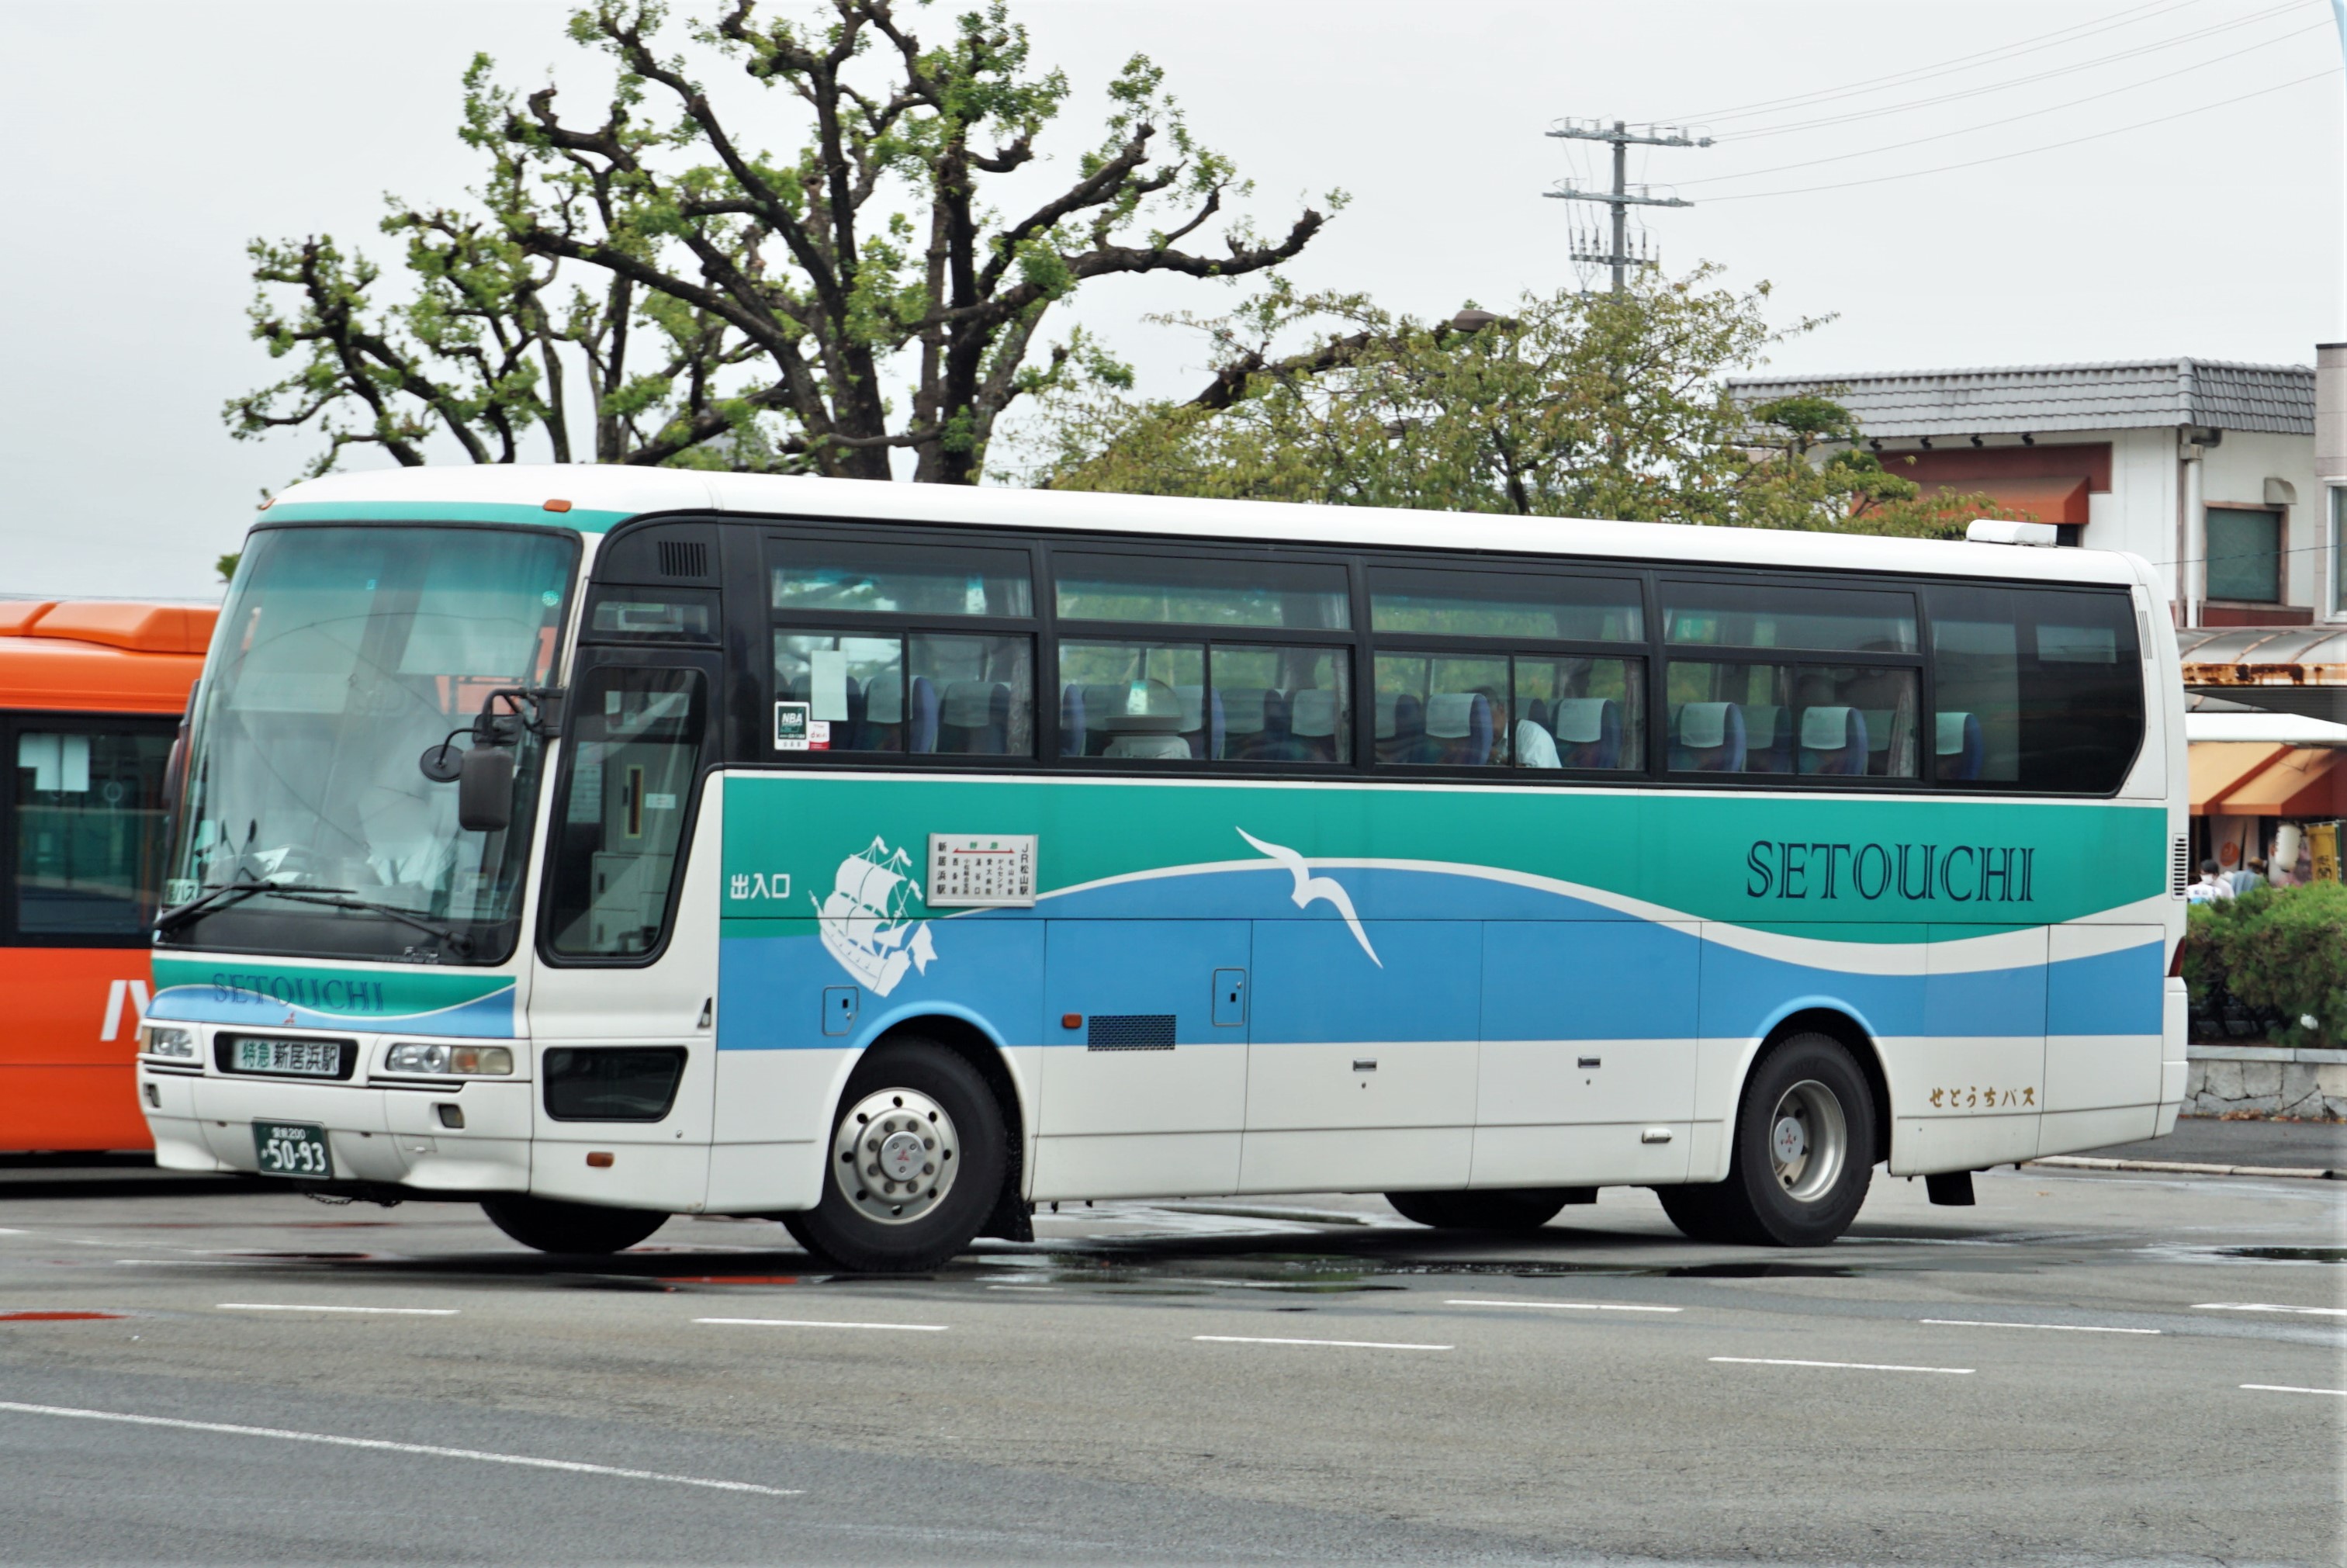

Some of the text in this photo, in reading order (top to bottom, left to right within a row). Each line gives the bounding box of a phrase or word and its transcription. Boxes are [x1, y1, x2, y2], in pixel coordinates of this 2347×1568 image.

[782, 712, 803, 723] NBA
[730, 873, 791, 899] 出入口
[936, 842, 947, 895] 新居浜駅
[1019, 843, 1029, 895] JR松山駅
[1746, 840, 2035, 902] SETOUCHI
[213, 973, 384, 1012] SETOUCHI
[243, 1040, 338, 1071] 特急 新居浜駅
[1930, 1086, 2034, 1108] せとうちバス
